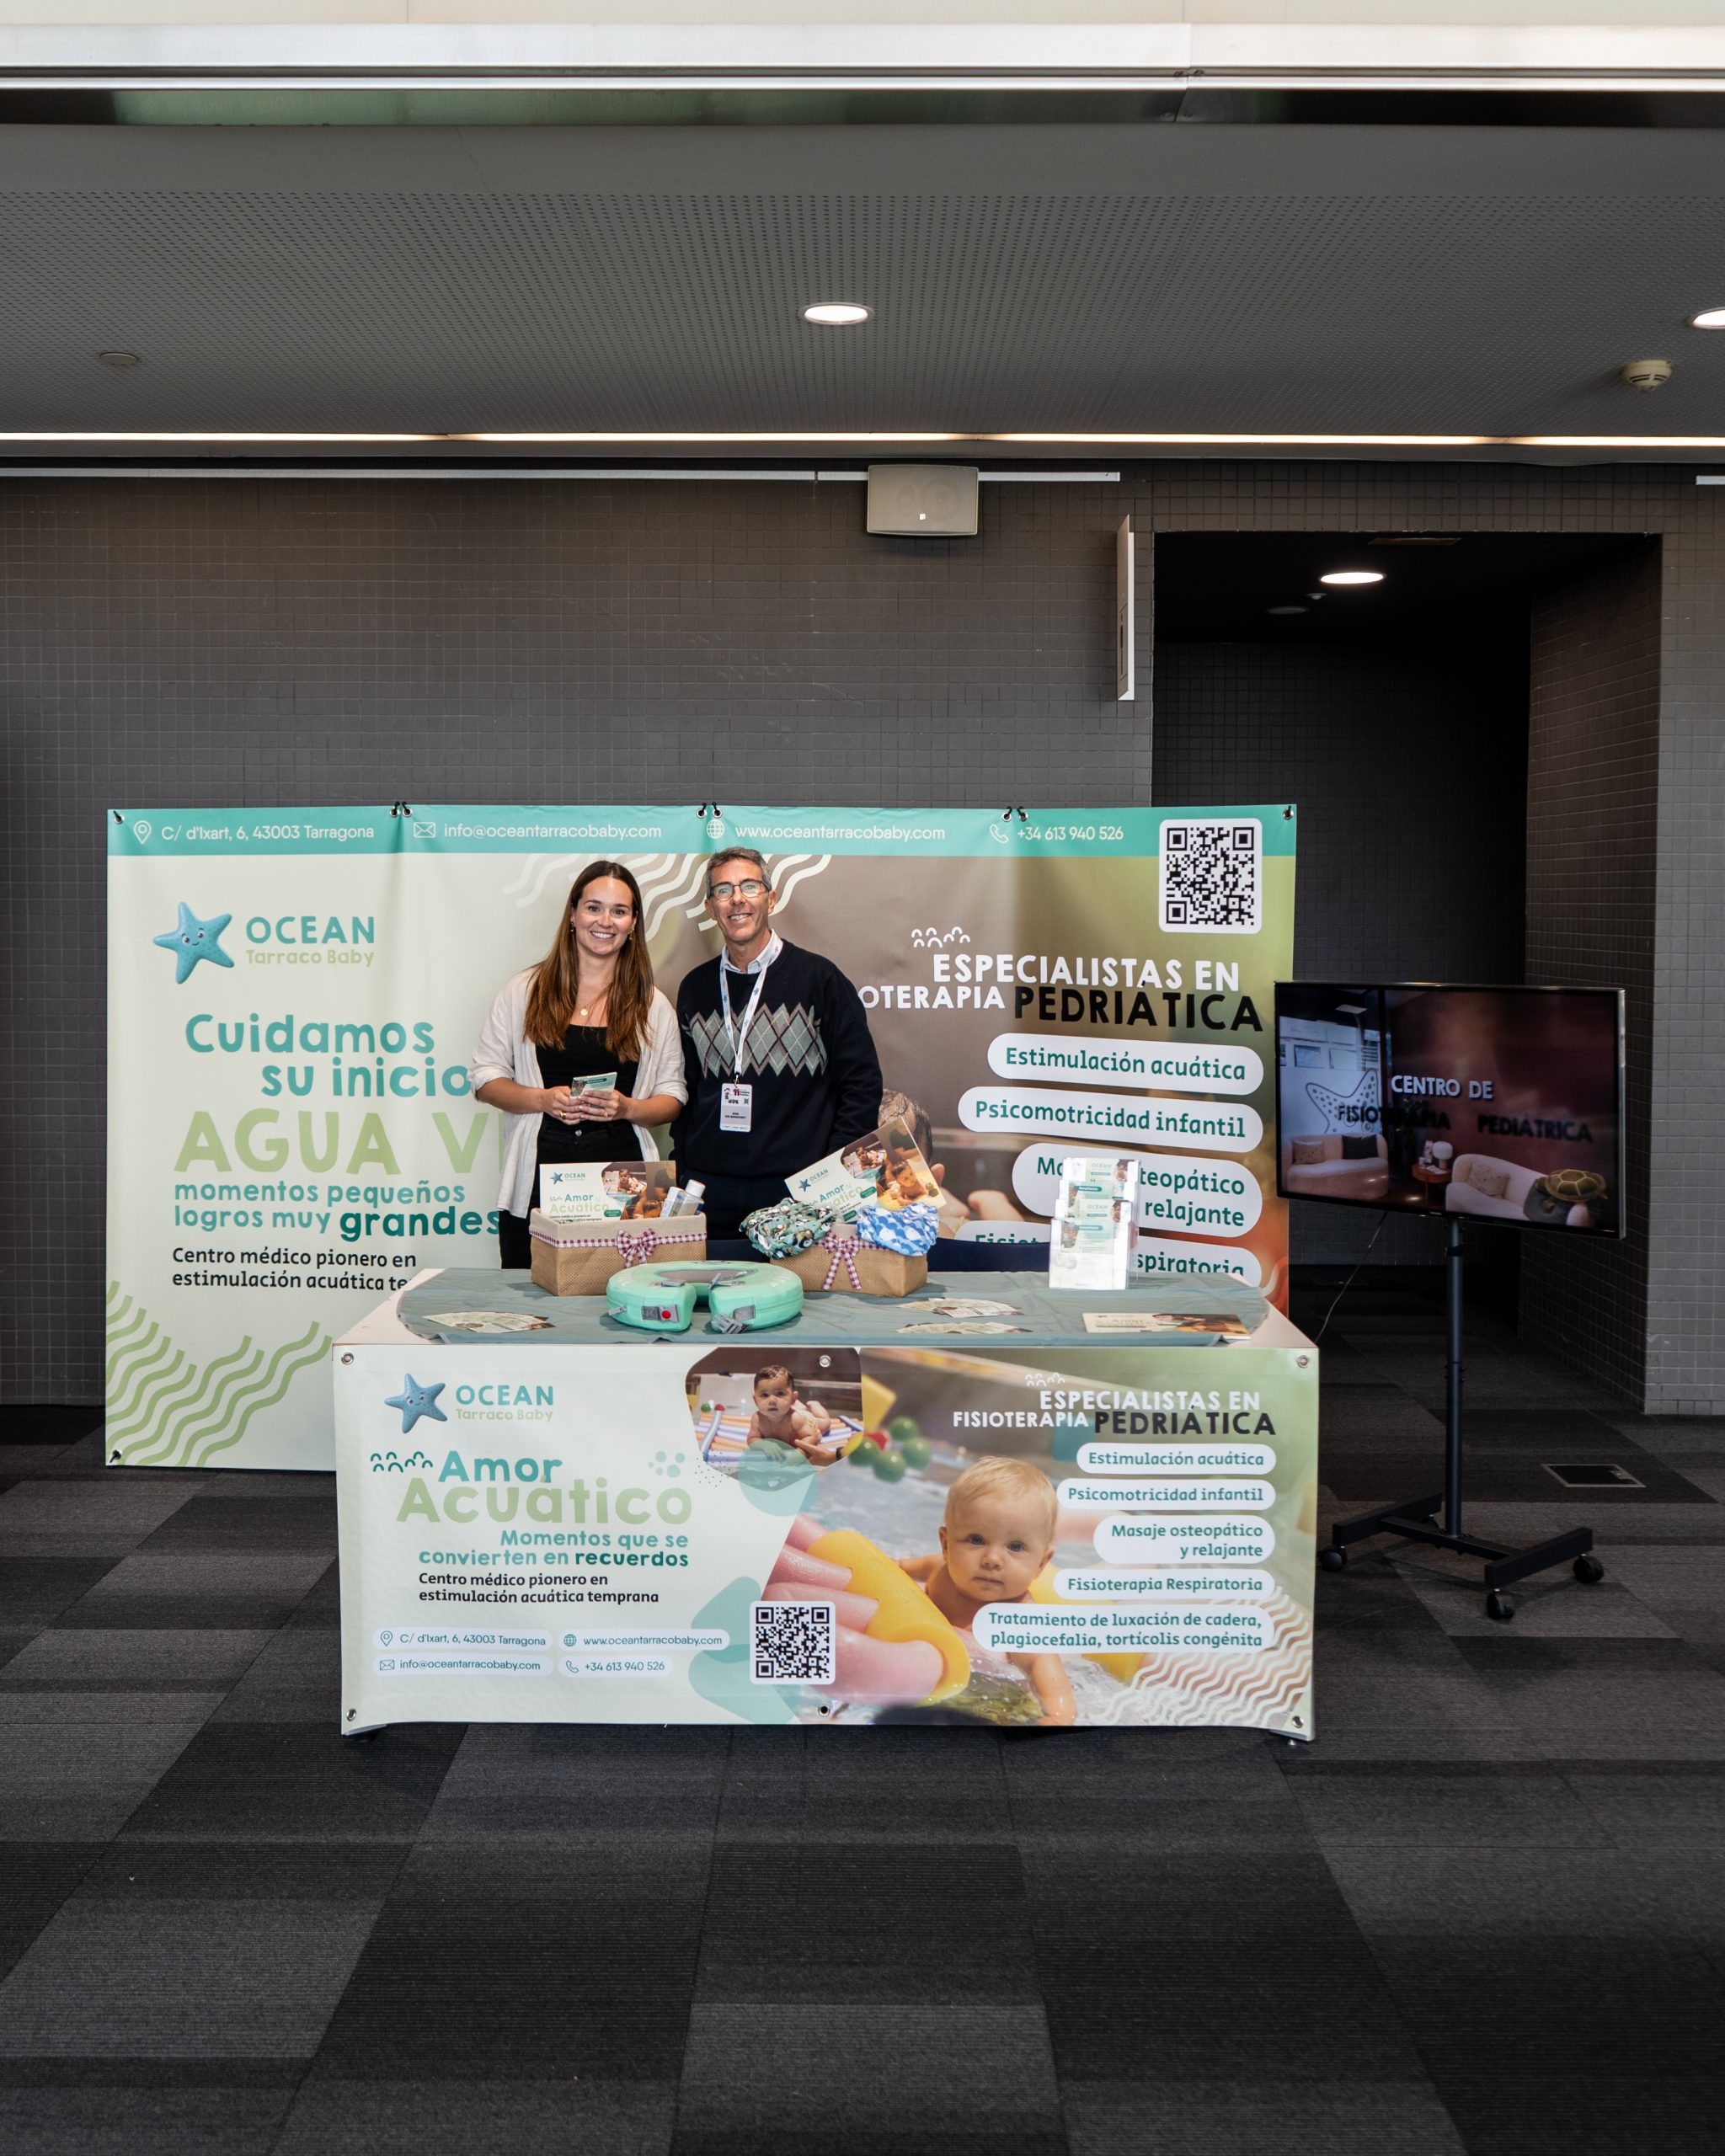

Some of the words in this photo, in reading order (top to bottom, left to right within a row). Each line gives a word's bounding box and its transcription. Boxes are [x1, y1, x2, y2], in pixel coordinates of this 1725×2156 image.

[162, 825, 181, 841] C/
[186, 826, 232, 841] d'Ixart,
[237, 826, 248, 841] 6,
[253, 825, 300, 839] 43003
[304, 825, 374, 841] Tarragona
[445, 824, 661, 841] info@oceantarracobaby.com
[735, 825, 945, 842] www.oceantarracobaby.com
[1017, 827, 1041, 840] +34
[1044, 827, 1065, 841] 613
[1070, 826, 1095, 840] 940
[1099, 826, 1124, 840] 526
[246, 916, 374, 944] OCEAN
[246, 950, 322, 963] Tarraco
[328, 949, 374, 967] Baby
[933, 954, 1182, 989] ESPECIALISTAS
[1196, 961, 1238, 991] EN
[858, 985, 1006, 1009] OTERAPIA
[185, 1013, 434, 1054] Cuidamos
[1007, 1048, 1144, 1073] Estimulación
[1151, 1056, 1245, 1080] acuática
[262, 1065, 313, 1097] su
[332, 1057, 472, 1097] inicio
[1391, 1075, 1461, 1097] CENTRO
[1469, 1081, 1493, 1100] DE
[977, 1100, 1149, 1129] Psicomotricidad
[1156, 1113, 1245, 1137] infantil
[174, 1108, 401, 1175] AGUA
[809, 1169, 828, 1181] OCEAN
[1140, 1168, 1245, 1194] teopático
[175, 1181, 318, 1202] momentos
[328, 1180, 465, 1209] pequeños
[820, 1184, 844, 1202] Amor
[1146, 1199, 1244, 1226] relajante
[175, 1205, 263, 1232] logros
[273, 1212, 330, 1234] muy
[340, 1206, 499, 1241] grandes
[174, 1248, 234, 1262] Centro
[241, 1246, 311, 1264] médico
[317, 1249, 387, 1269] pionero
[393, 1256, 415, 1267] en
[173, 1270, 301, 1287] estimulación
[307, 1272, 383, 1290] acuática
[456, 1385, 553, 1406] OCEAN
[1040, 1389, 1220, 1411] ESPECIALISTAS
[1230, 1391, 1259, 1410] EN
[456, 1409, 512, 1420] Tarraco
[517, 1409, 553, 1422] Baby
[953, 1412, 1088, 1427] FISIOTERAPIA
[1095, 1405, 1276, 1435] PEDRIÁTICA
[439, 1451, 563, 1483] Amor
[1089, 1451, 1193, 1465] Estimulación
[1198, 1451, 1263, 1465] acuática
[397, 1475, 692, 1524] Acuático
[1069, 1487, 1197, 1501] Psicomotricidad
[1201, 1488, 1263, 1501] infantil
[501, 1530, 611, 1546] Momentos
[618, 1535, 658, 1550] que
[665, 1535, 688, 1547] se
[1112, 1524, 1166, 1540] Masaje
[1170, 1523, 1263, 1539] osteopático
[419, 1550, 536, 1566] convierten
[544, 1553, 568, 1564] en
[576, 1551, 688, 1566] recuerdos
[1180, 1547, 1188, 1559] y
[1193, 1544, 1263, 1559] relajante
[419, 1573, 467, 1584] Centro
[471, 1573, 525, 1586] médico
[530, 1573, 586, 1588] pionero
[1069, 1577, 1162, 1593] Fisioterapia
[1167, 1577, 1262, 1593] Respiratoria
[419, 1589, 516, 1603] estimulación
[521, 1589, 584, 1603] acuática
[588, 1592, 658, 1604] temprana
[989, 1613, 1086, 1626] Tratamiento
[1091, 1614, 1108, 1626] de
[1113, 1612, 1179, 1625] luxación
[1183, 1613, 1201, 1625] de
[1205, 1614, 1261, 1628] cadera,
[400, 1634, 414, 1643] C/
[418, 1634, 449, 1645] d'Ixart,
[452, 1635, 460, 1645] 6,
[463, 1635, 495, 1643] 43003
[499, 1636, 546, 1646] Tarragona
[584, 1636, 722, 1646] www.oceantarracobaby.com
[991, 1631, 1101, 1648] plagiocefalia,
[1106, 1631, 1179, 1645] tortícolis
[1183, 1632, 1262, 1648] congénita
[400, 1660, 540, 1671] info@oceantarracobaby.com
[585, 1662, 603, 1671] +34
[606, 1662, 622, 1671] 613
[625, 1662, 644, 1670] 940
[647, 1662, 665, 1670] 526
